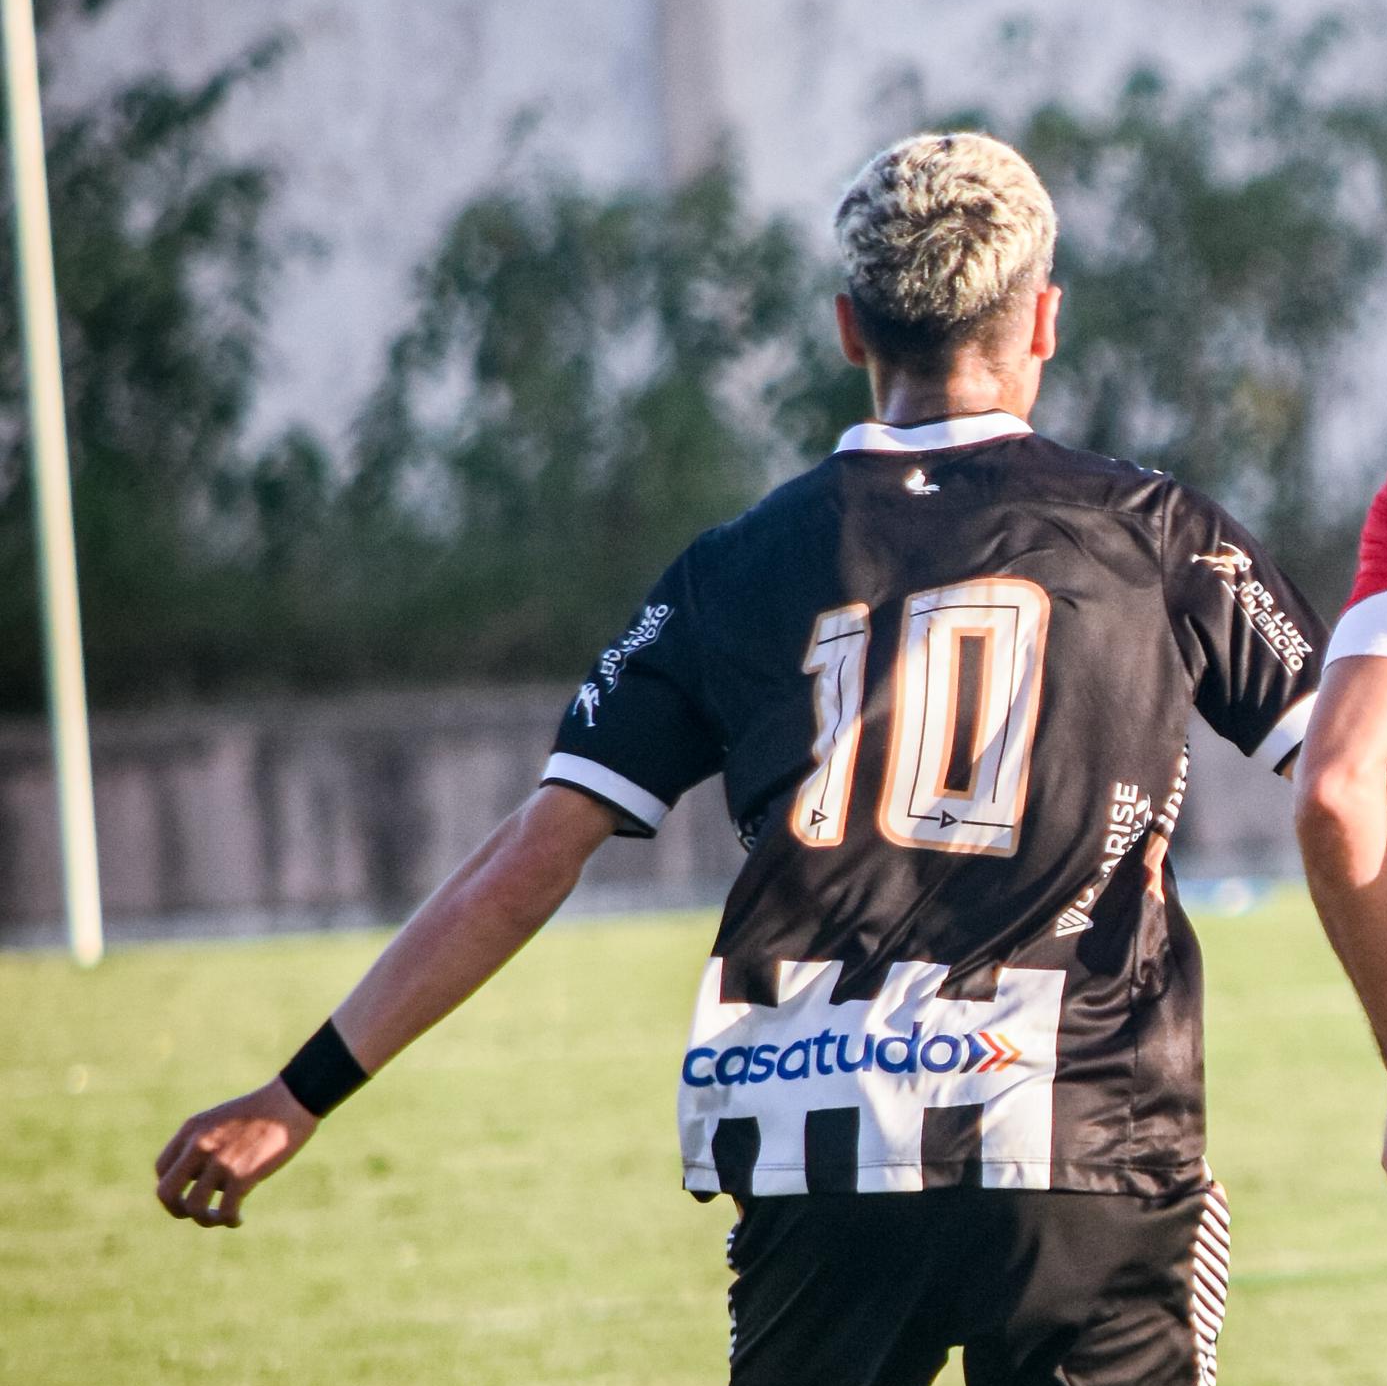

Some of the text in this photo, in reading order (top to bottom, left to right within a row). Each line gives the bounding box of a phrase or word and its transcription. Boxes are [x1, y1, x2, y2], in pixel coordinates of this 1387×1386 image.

[1231, 581, 1304, 671] JUVENCIO
[1249, 580, 1313, 658] DR. LUIZ
[791, 577, 1051, 858] 10
[682, 1021, 963, 1087] casatudo
